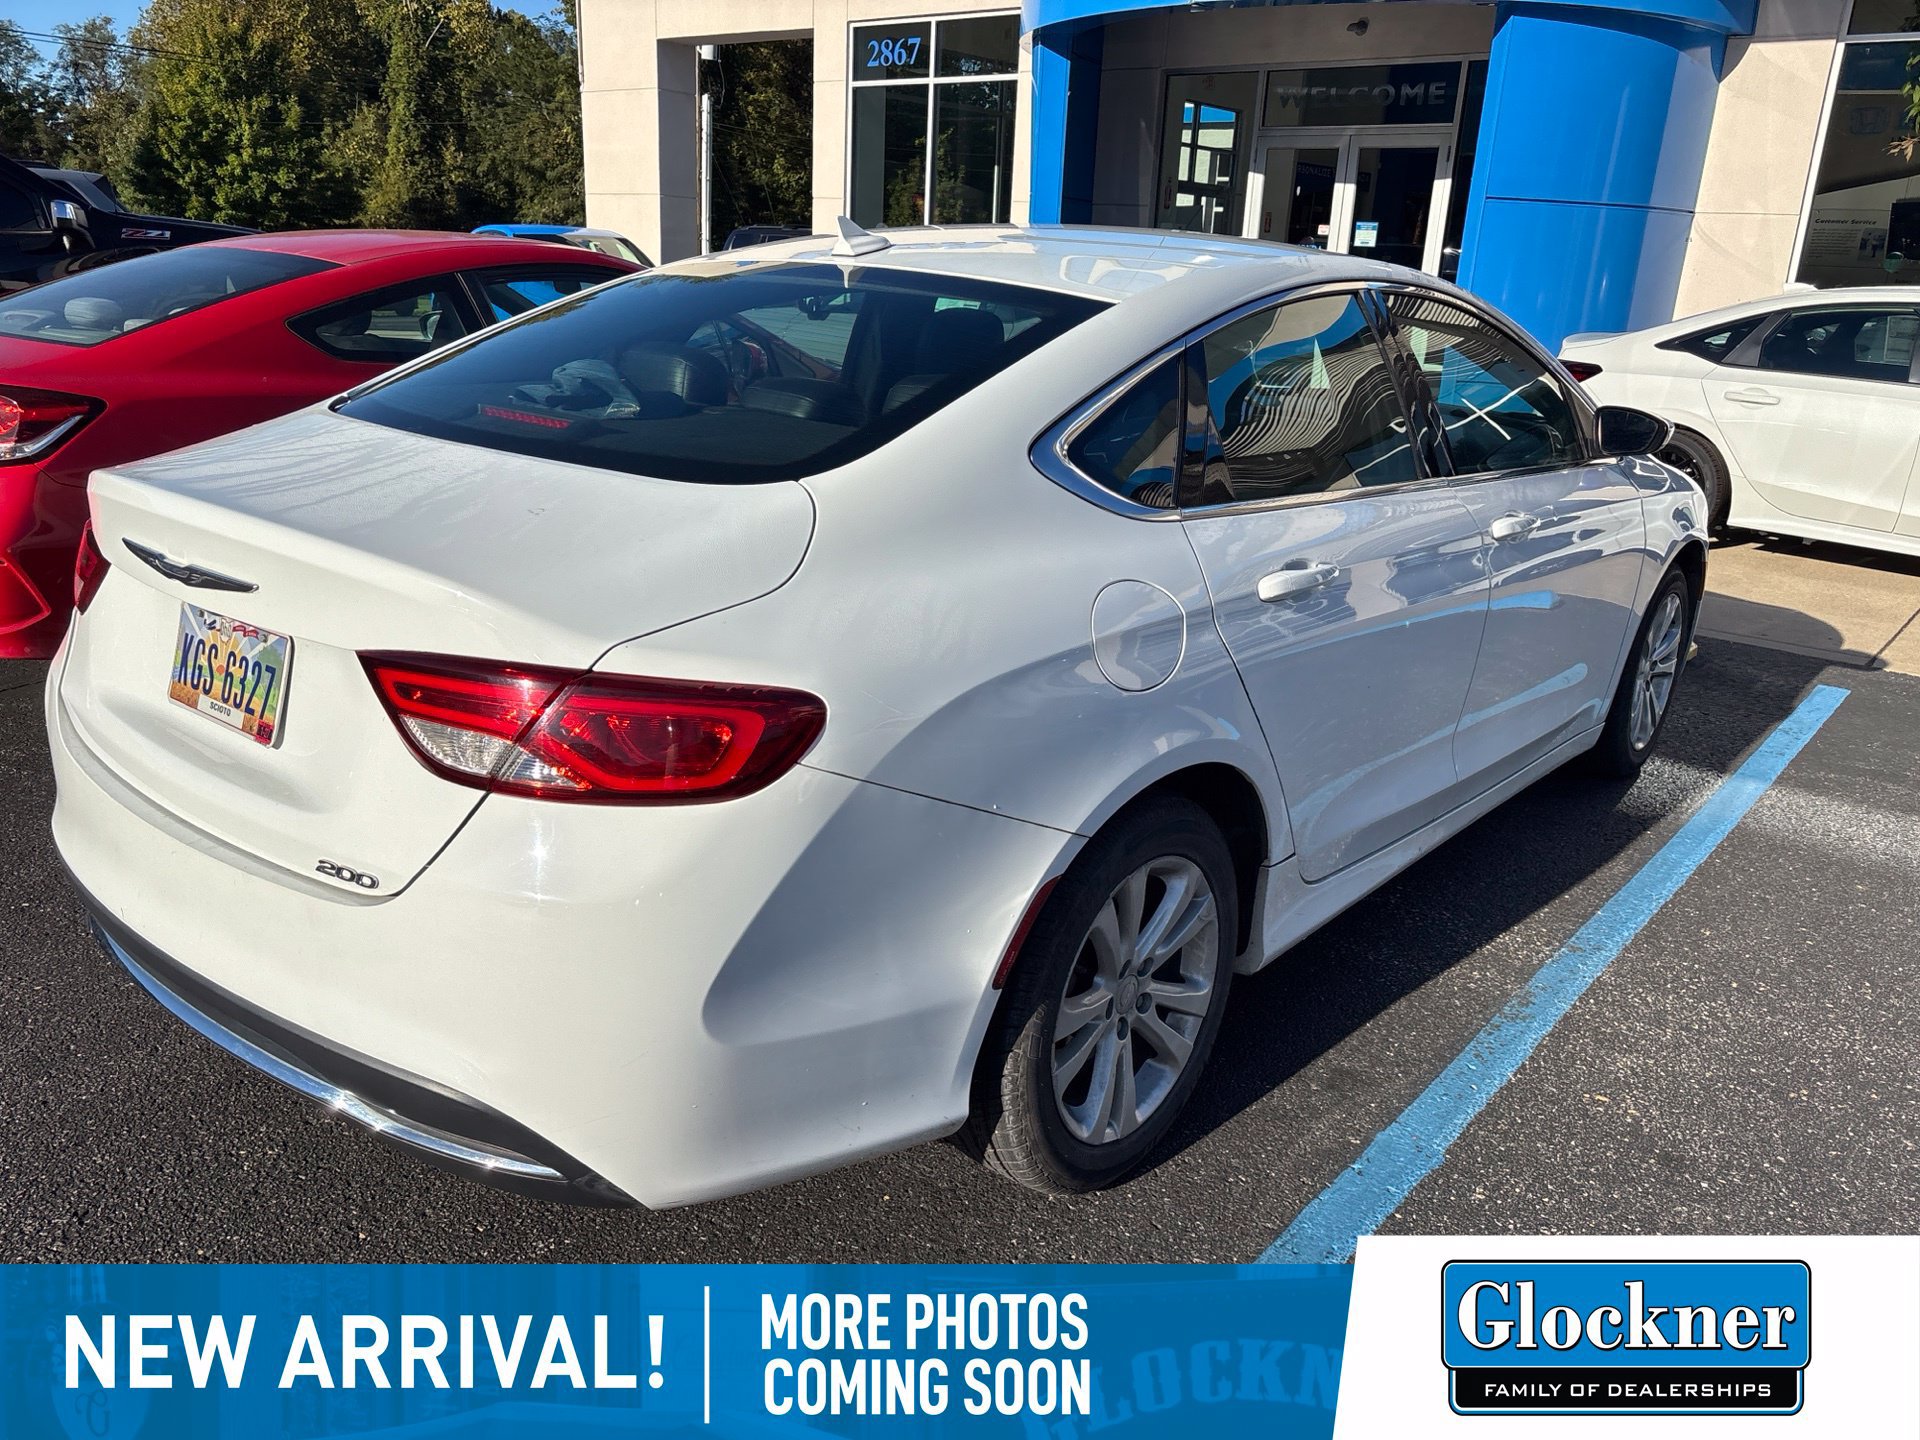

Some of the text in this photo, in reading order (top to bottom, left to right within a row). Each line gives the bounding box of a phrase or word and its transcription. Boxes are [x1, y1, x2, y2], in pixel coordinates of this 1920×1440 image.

[867, 37, 921, 67] 2867
[1276, 82, 1447, 109] WELCOME
[178, 633, 276, 721] KGS 6327
[209, 701, 232, 717] SCIOTO
[315, 859, 379, 889] 200
